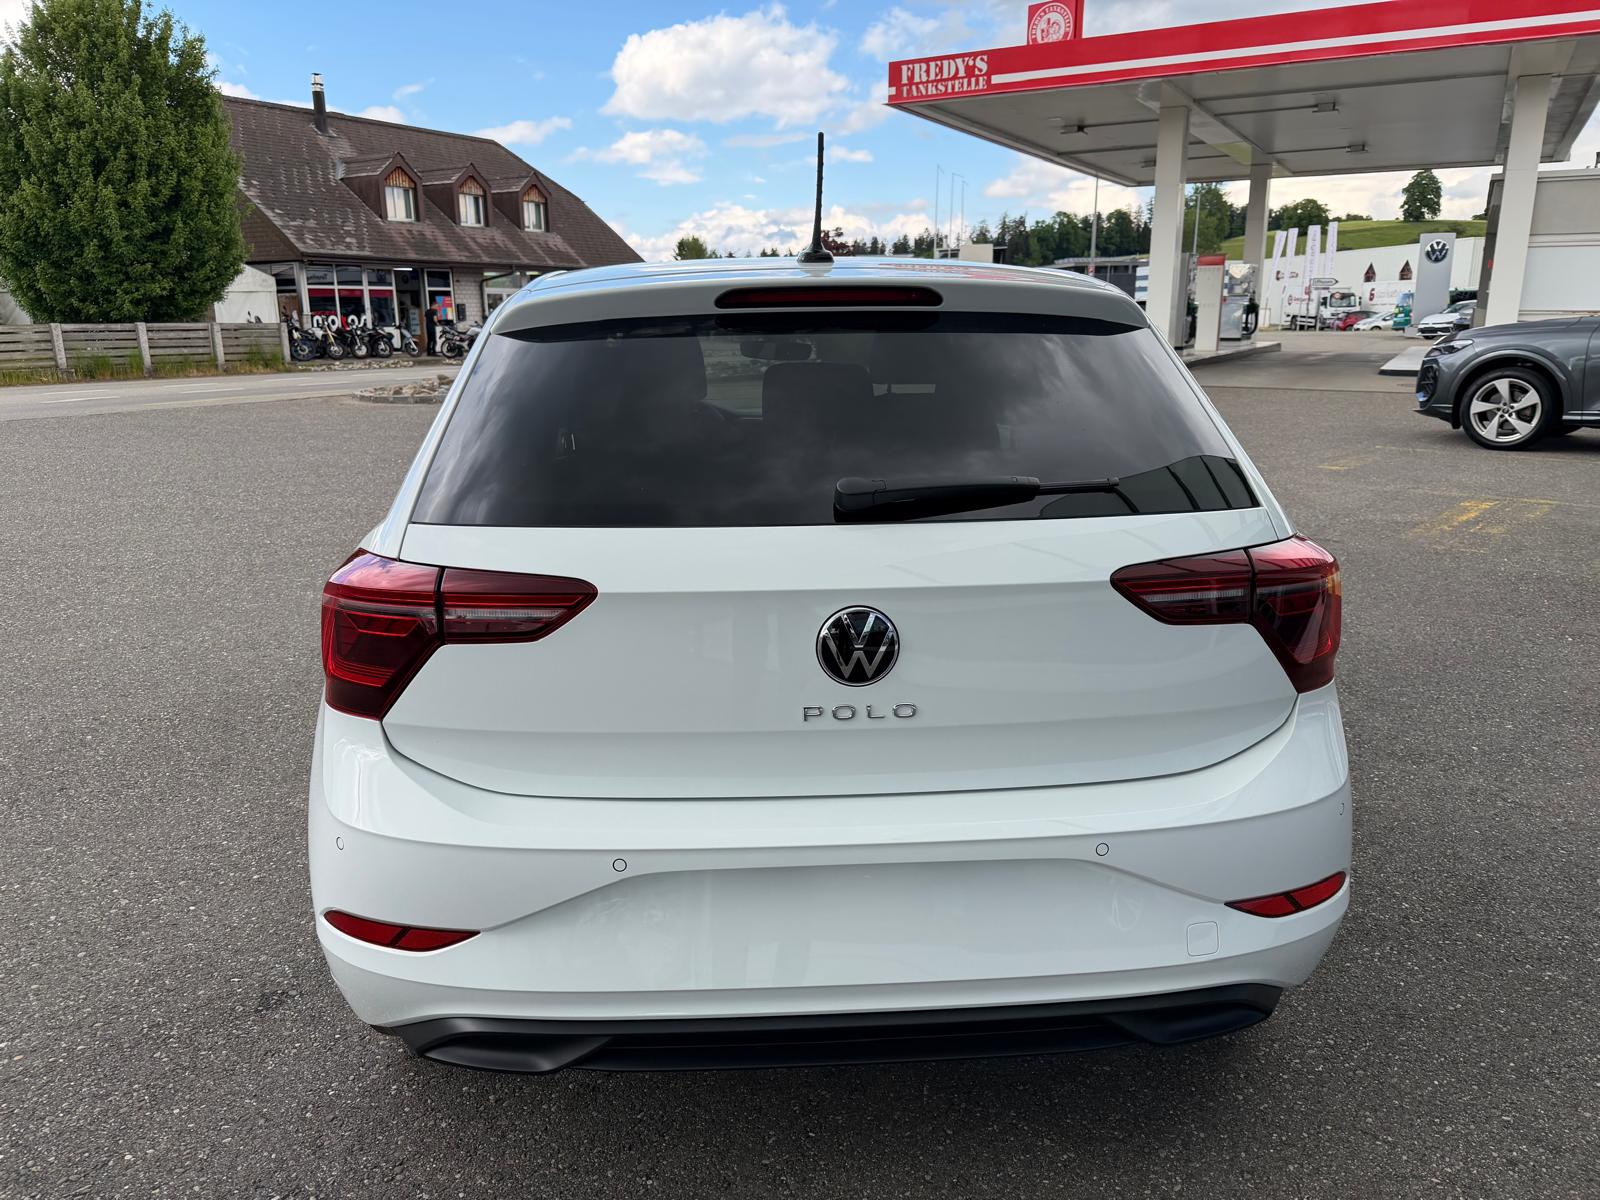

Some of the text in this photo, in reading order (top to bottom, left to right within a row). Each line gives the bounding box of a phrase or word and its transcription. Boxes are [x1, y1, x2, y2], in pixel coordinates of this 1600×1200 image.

[902, 76, 988, 97] TANKSTELLE
[821, 610, 898, 682] VW
[803, 702, 918, 722] POLO
